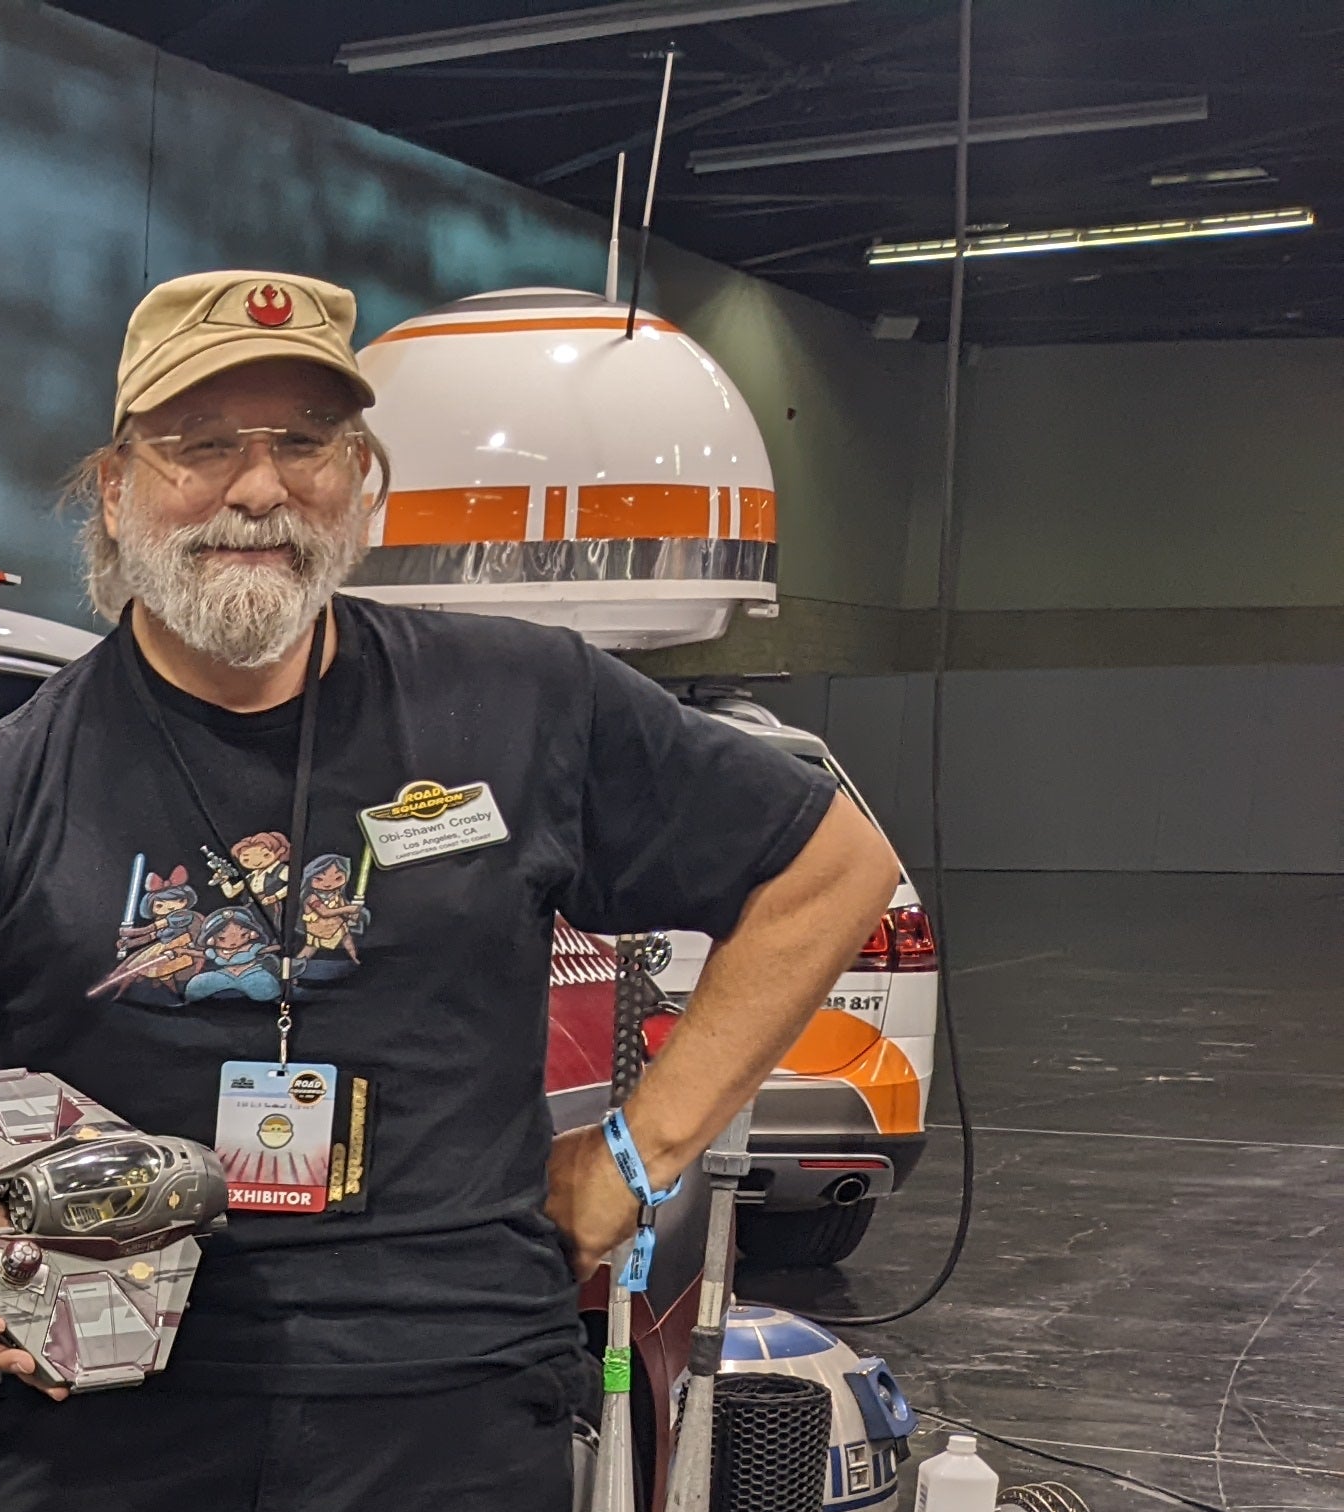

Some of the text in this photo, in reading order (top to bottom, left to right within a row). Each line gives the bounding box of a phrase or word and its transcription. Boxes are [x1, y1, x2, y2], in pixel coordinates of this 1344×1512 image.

[391, 793, 463, 815] SQUADRON
[406, 787, 442, 802] ROAD
[378, 812, 491, 844] Obi-Shawn Crosby
[403, 840, 420, 850] Los
[463, 827, 477, 836] CA
[294, 1080, 322, 1088] ROAD
